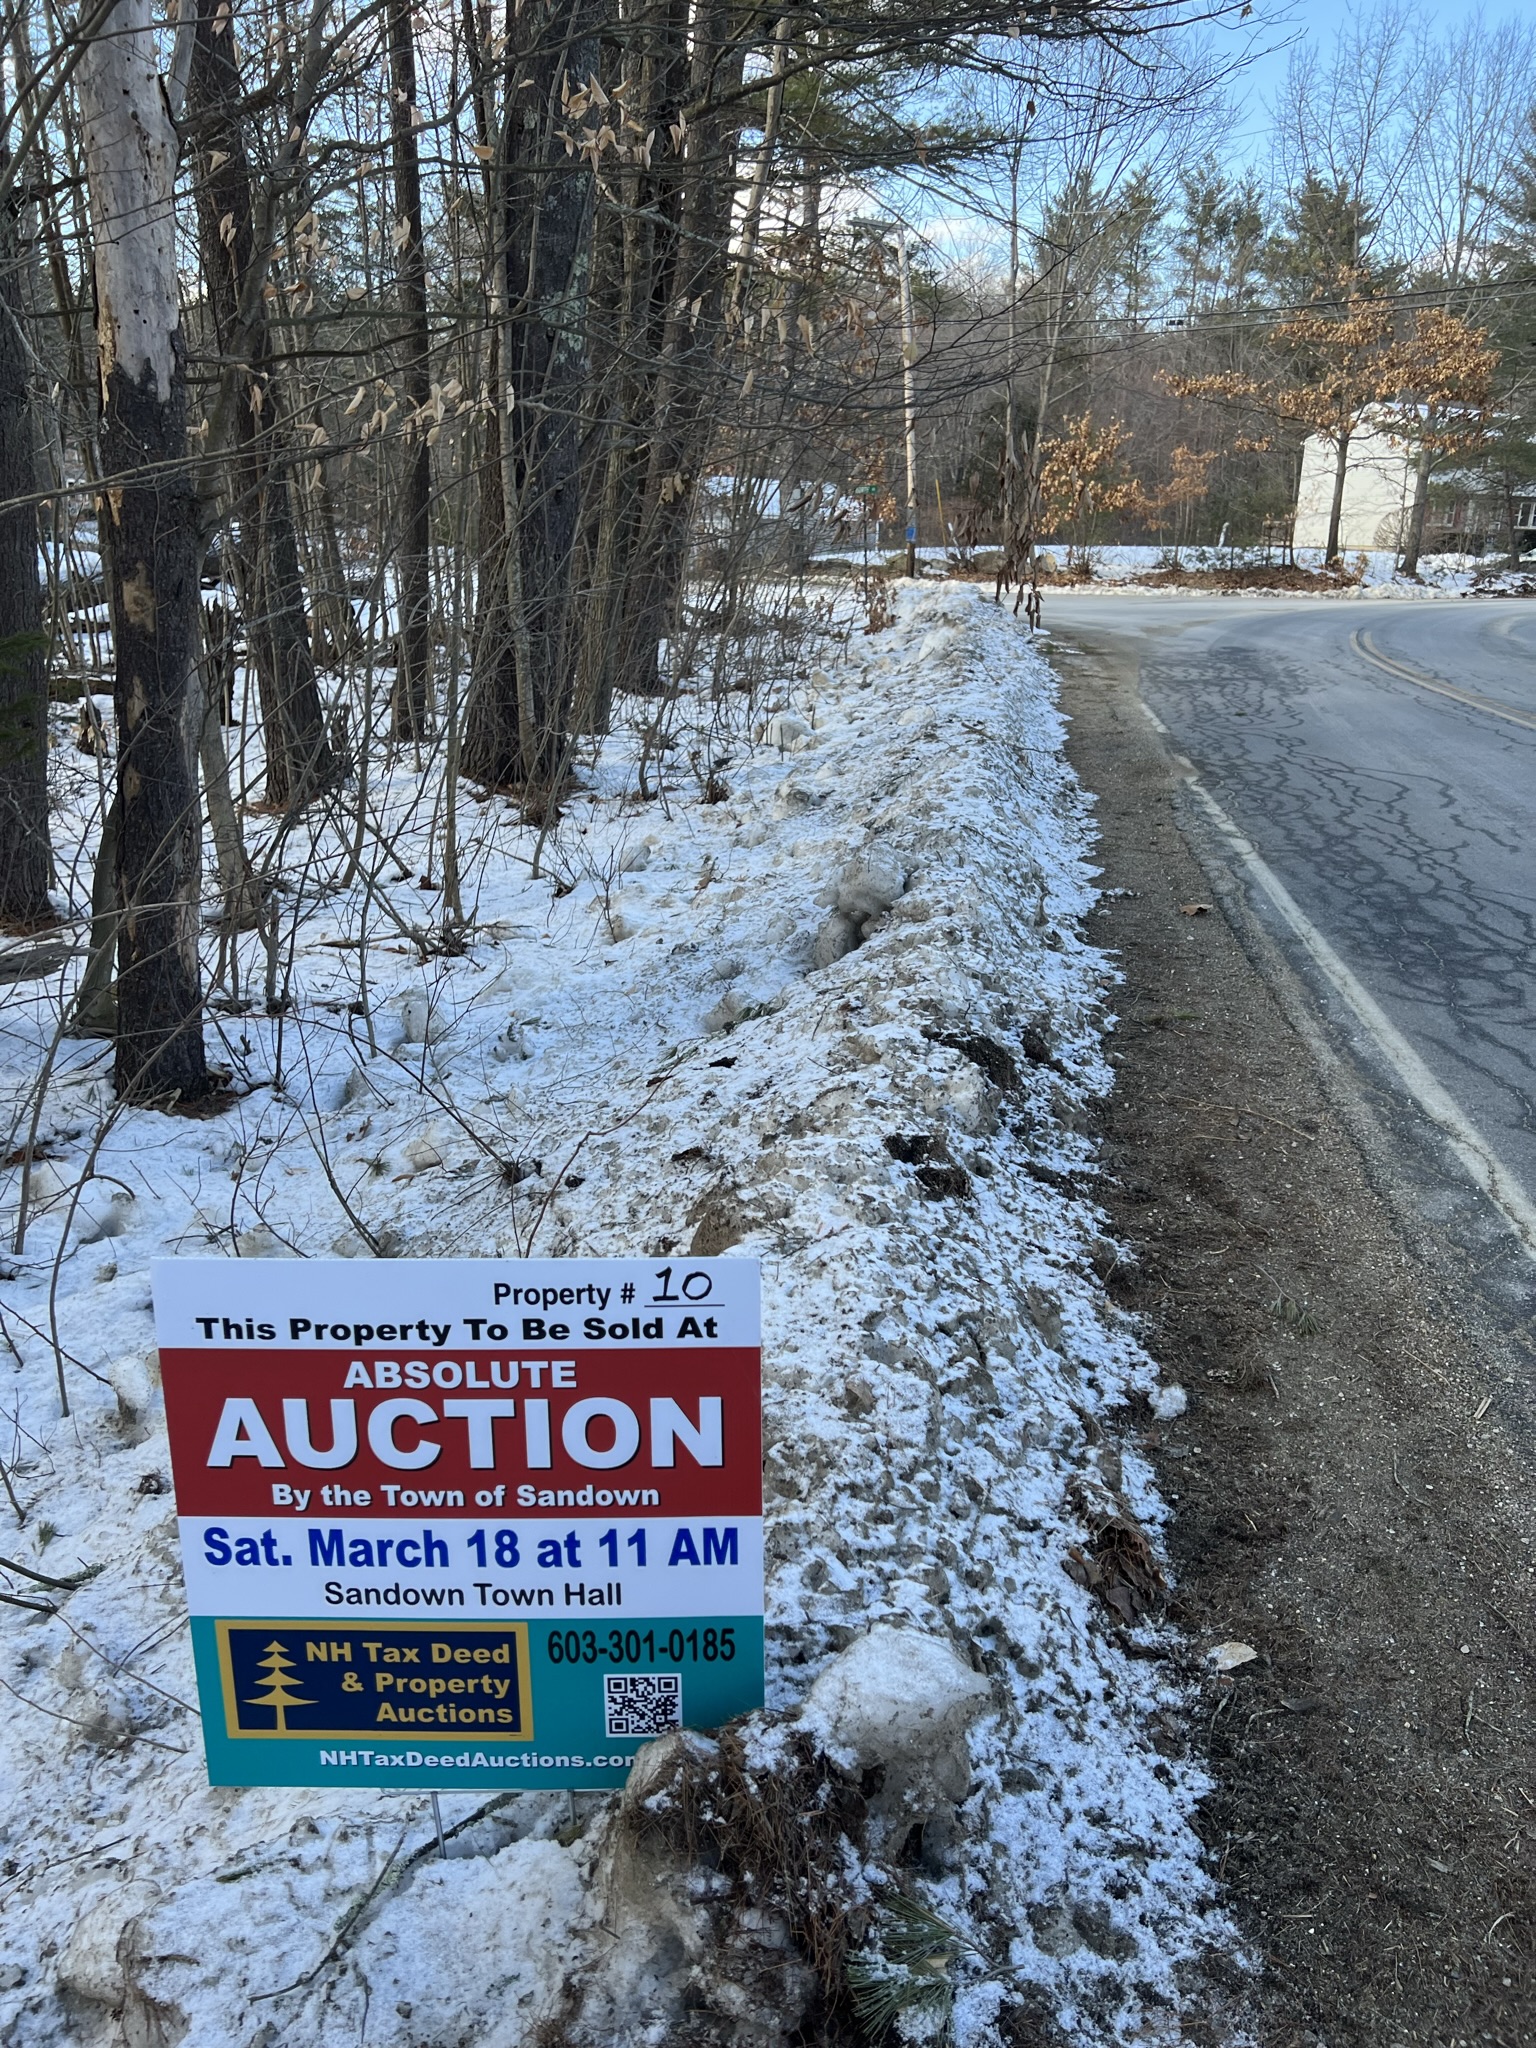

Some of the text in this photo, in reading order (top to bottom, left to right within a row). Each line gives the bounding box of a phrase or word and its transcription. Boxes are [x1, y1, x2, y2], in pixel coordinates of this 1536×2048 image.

[493, 1266, 712, 1311] Property # 10
[196, 1317, 718, 1346] This Property To Be Sold At
[343, 1361, 578, 1390] ABSOLUTE
[206, 1396, 725, 1471] AUCTION
[272, 1483, 660, 1511] By the Town of Sandown
[203, 1527, 739, 1568] Sat. March 18 at 11 AM
[324, 1581, 622, 1606] Sandown Town Hall
[305, 1642, 510, 1665] NH Tax Deed
[547, 1628, 736, 1664] 603-301-0185
[342, 1672, 511, 1698] & Property
[376, 1702, 514, 1724] Auctions
